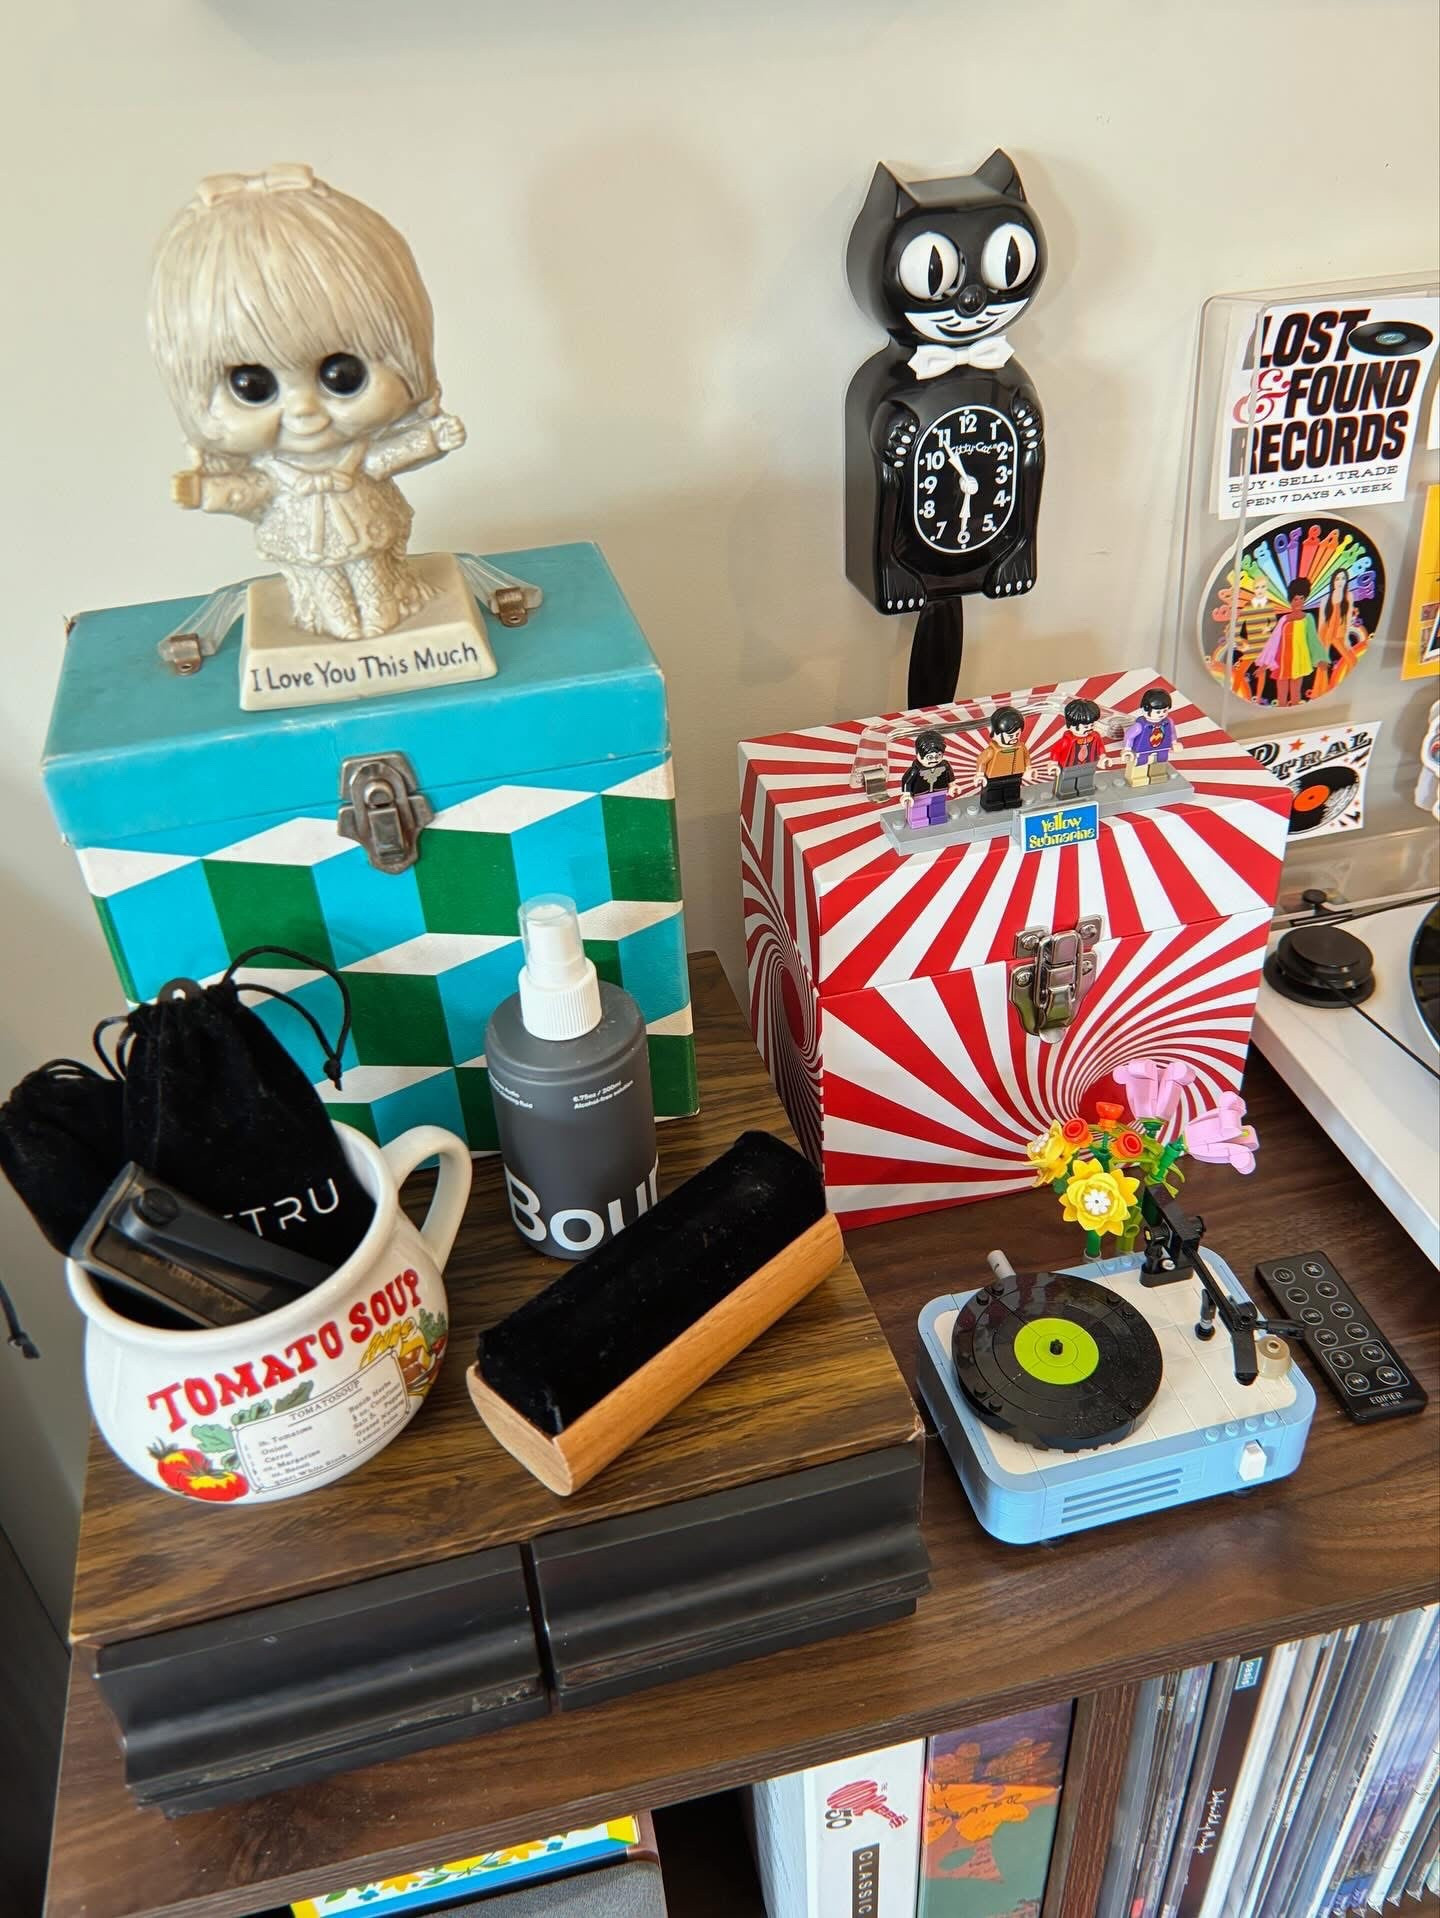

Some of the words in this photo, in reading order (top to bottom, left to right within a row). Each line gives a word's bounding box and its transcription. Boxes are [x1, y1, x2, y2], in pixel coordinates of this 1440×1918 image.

[1242, 309, 1371, 370] LOST
[1233, 369, 1291, 424] &
[1284, 359, 1421, 419] FOUND
[959, 414, 977, 434] 12
[990, 422, 998, 440] 1
[937, 428, 951, 447] 11
[1229, 411, 1409, 478] RECORDS
[925, 451, 945, 471] 10
[996, 442, 1008, 461] 2
[924, 476, 938, 494] 9
[995, 466, 1007, 484] 3
[1278, 474, 1325, 487] SELL
[1336, 465, 1399, 480] TRADE
[993, 490, 1006, 507] 4
[1280, 495, 1288, 503] 7
[1291, 490, 1330, 502] DAYS
[1333, 488, 1346, 497] A
[923, 500, 935, 519] 8
[936, 521, 947, 539] 7
[982, 514, 994, 532] 5
[1273, 527, 1302, 554] OF
[1302, 524, 1377, 601] RAINBOW
[250, 669, 262, 692] I
[266, 667, 314, 690] Love
[314, 661, 356, 687] You
[358, 655, 408, 679] This
[413, 642, 478, 672] Much
[1268, 731, 1373, 780] TRAL
[1041, 811, 1082, 833] Yellow
[1029, 827, 1095, 849] Submarine
[223, 1178, 339, 1237] TRU
[147, 1320, 345, 1432] TOMATO
[348, 1268, 424, 1344] SOUP
[1369, 1391, 1404, 1405] EDIFIER
[857, 1850, 874, 1915] CLASSIC
